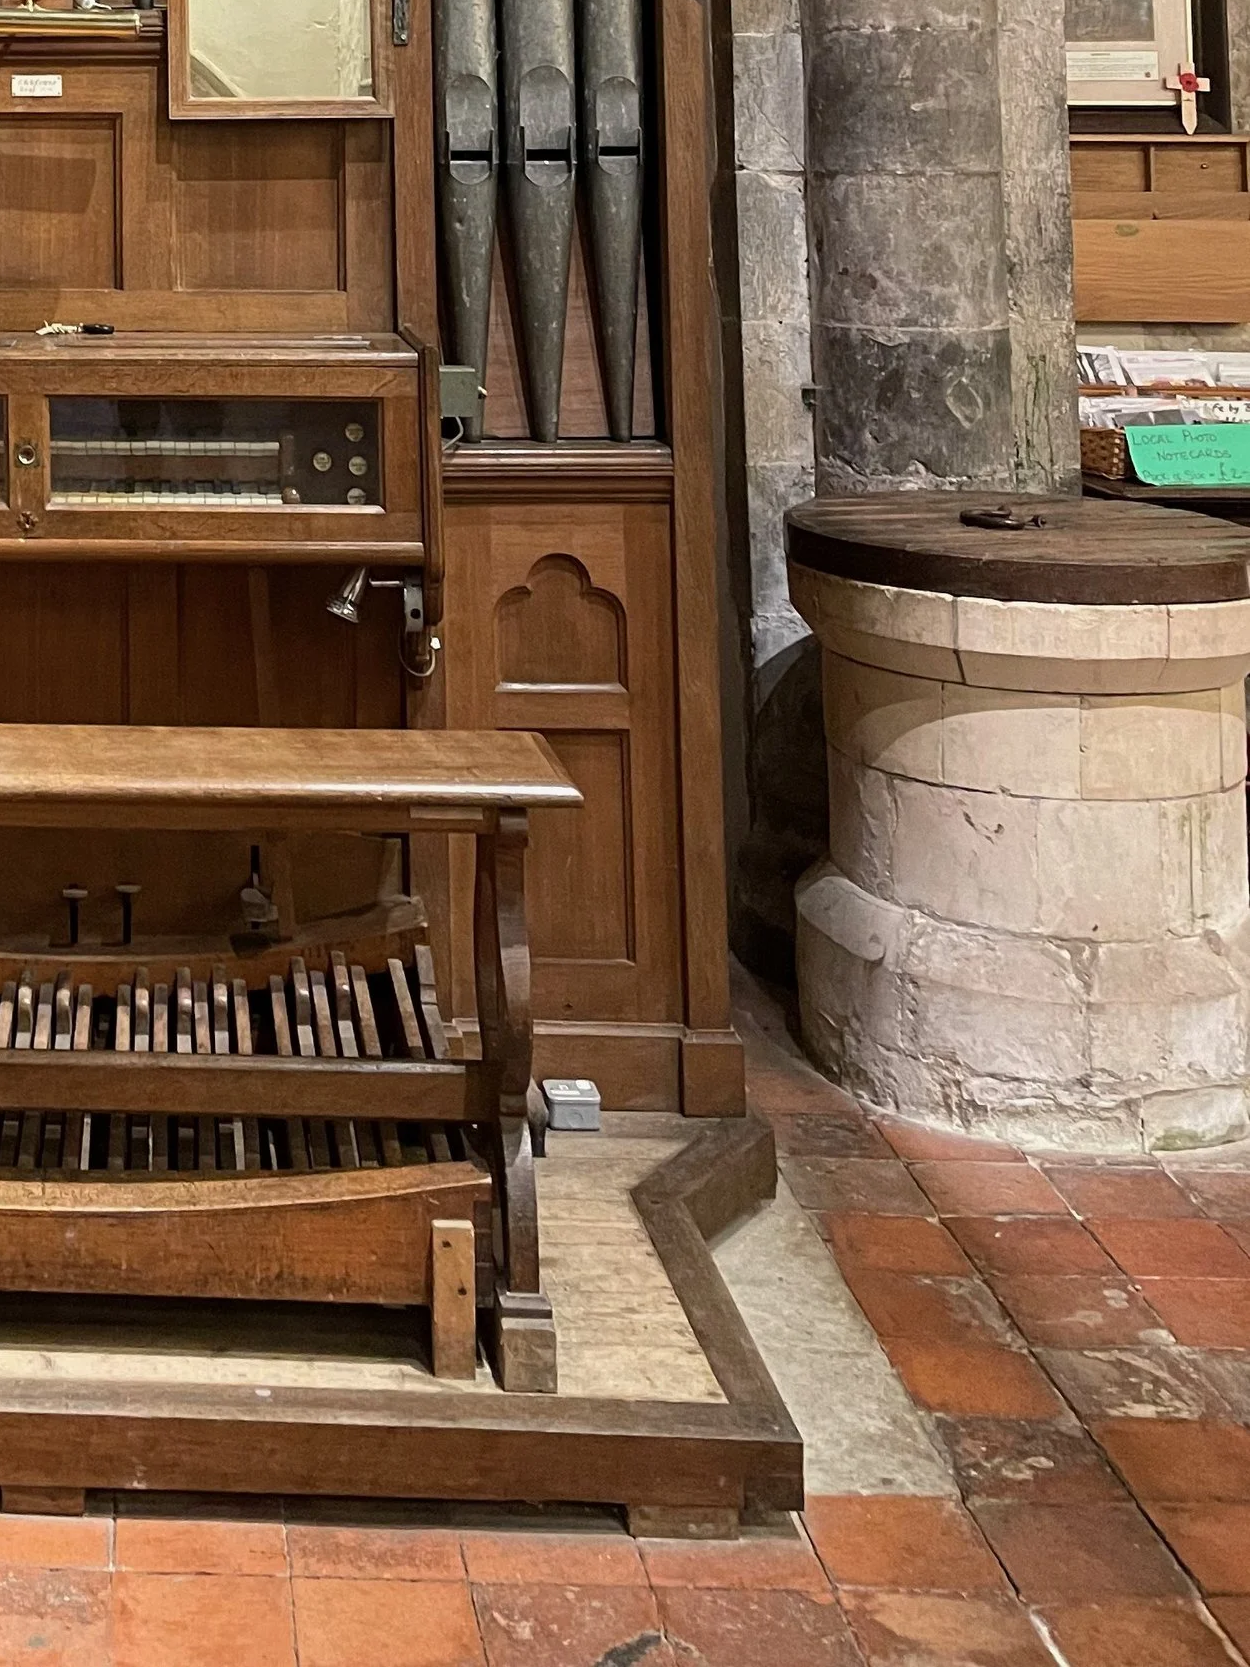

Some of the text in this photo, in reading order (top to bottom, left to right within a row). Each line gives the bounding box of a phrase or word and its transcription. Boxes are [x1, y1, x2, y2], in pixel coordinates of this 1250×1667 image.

[1131, 429, 1217, 446] LOCAL PHOTO
[1156, 449, 1232, 461] NOTECARDS
